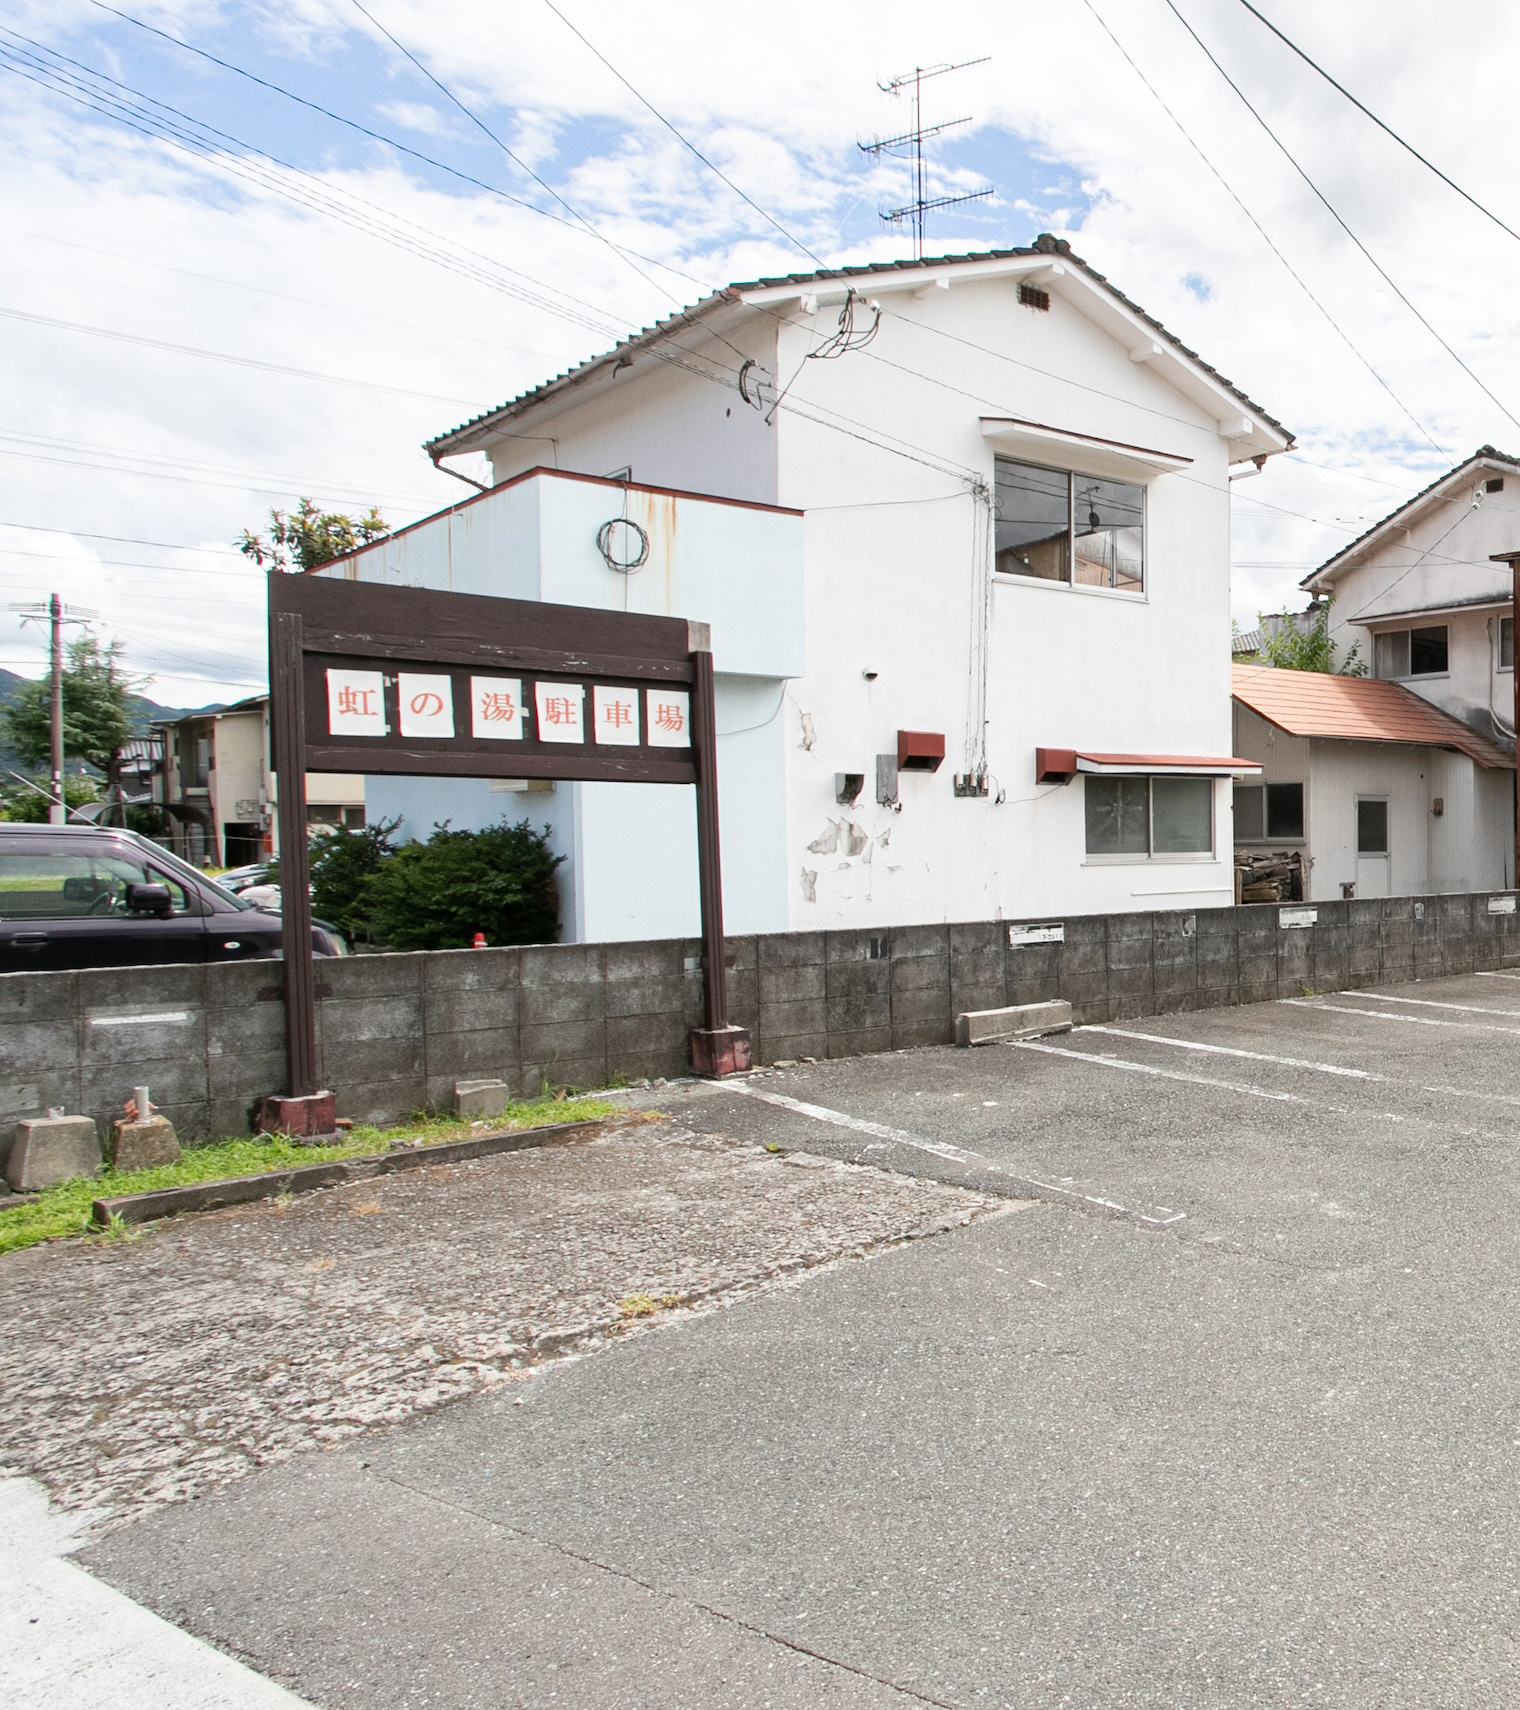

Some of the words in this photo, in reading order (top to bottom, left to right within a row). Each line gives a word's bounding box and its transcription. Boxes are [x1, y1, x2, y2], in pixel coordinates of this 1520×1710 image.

[338, 685, 684, 732] 虹の湯駐車場
